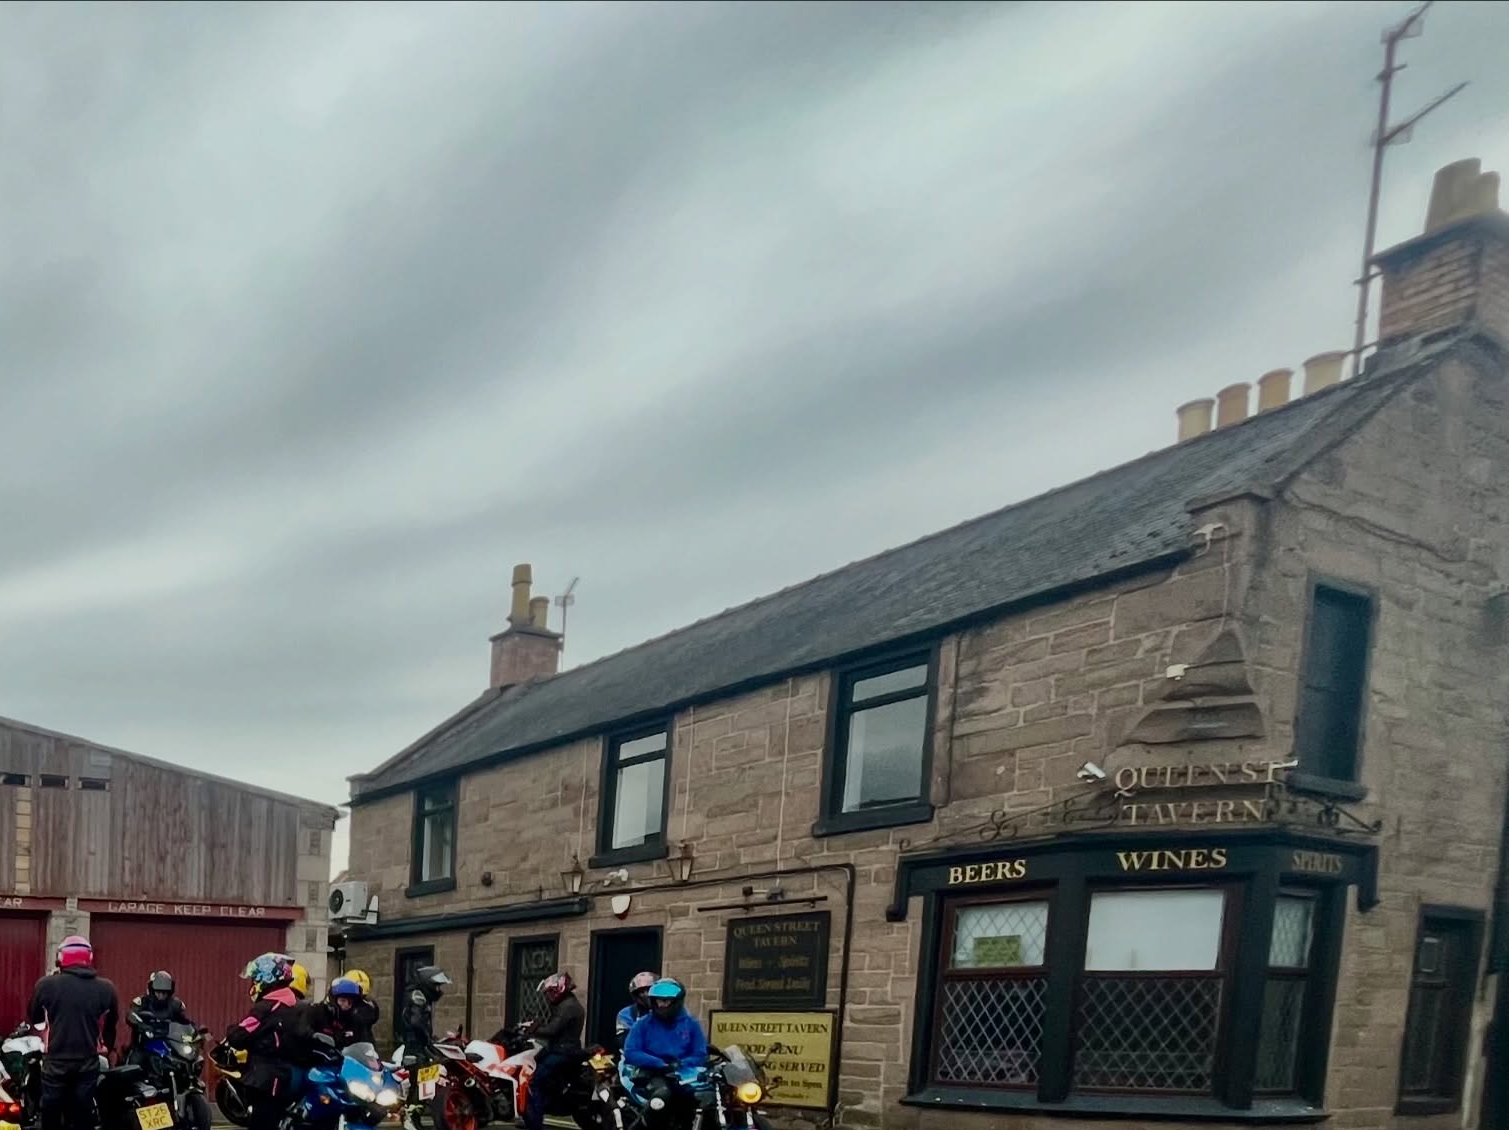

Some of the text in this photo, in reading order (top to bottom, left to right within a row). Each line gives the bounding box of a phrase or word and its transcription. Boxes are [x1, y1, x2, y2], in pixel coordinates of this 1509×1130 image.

[1114, 760, 1281, 798] QUEEN ST
[1123, 800, 1267, 825] TAVERN
[1116, 848, 1227, 871] WINES
[949, 859, 1027, 885] BEERS
[107, 902, 266, 917] GARAGE KEEP CLEAR
[717, 1022, 828, 1034] QUEEN STREET TAVERN
[778, 1061, 825, 1073] SERVED
[422, 1083, 433, 1097] L
